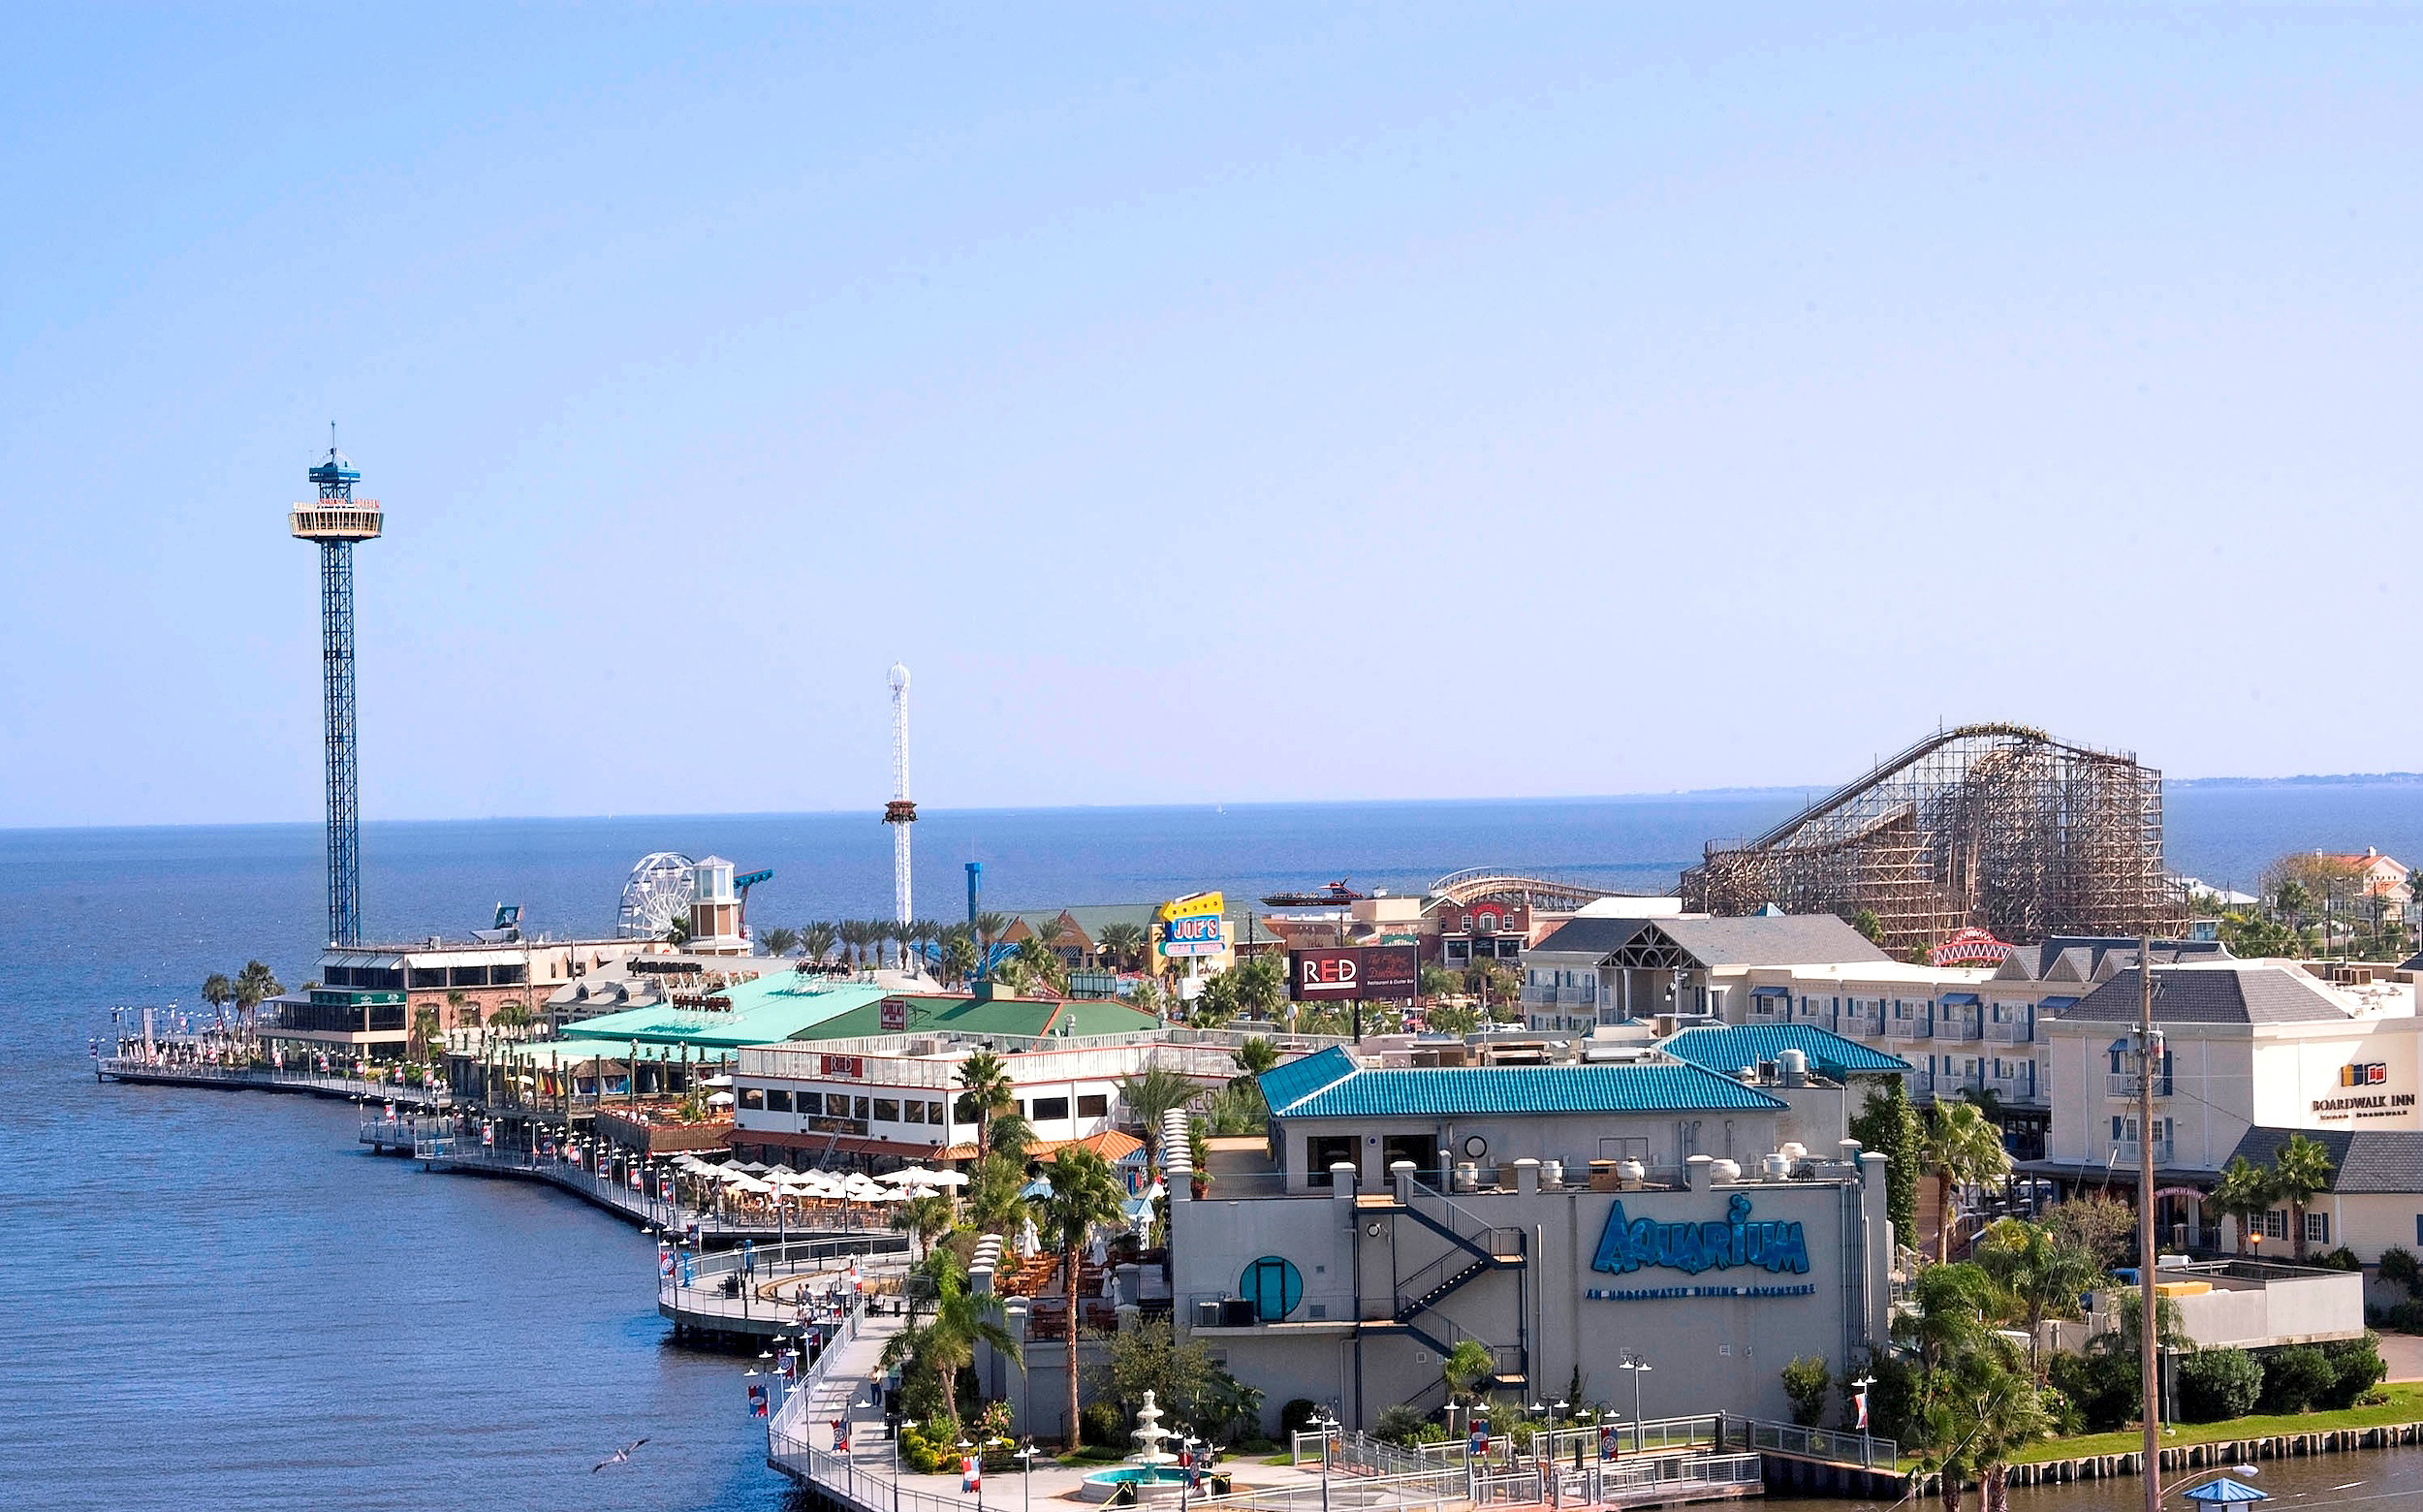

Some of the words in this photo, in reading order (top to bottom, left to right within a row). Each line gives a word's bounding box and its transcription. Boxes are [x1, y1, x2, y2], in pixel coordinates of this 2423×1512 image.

[1174, 918, 1218, 939] JOE'S
[1303, 959, 1357, 984] RED
[2312, 1095, 2388, 1111] BOARDWALK
[2391, 1094, 2415, 1107] INN
[2356, 1110, 2408, 1118] BOARDWALK
[1586, 1288, 1602, 1301] AN
[1608, 1286, 1688, 1301] UNDERWATER
[1694, 1285, 1739, 1298] DINING
[1746, 1283, 1816, 1298] ADVENTURE
